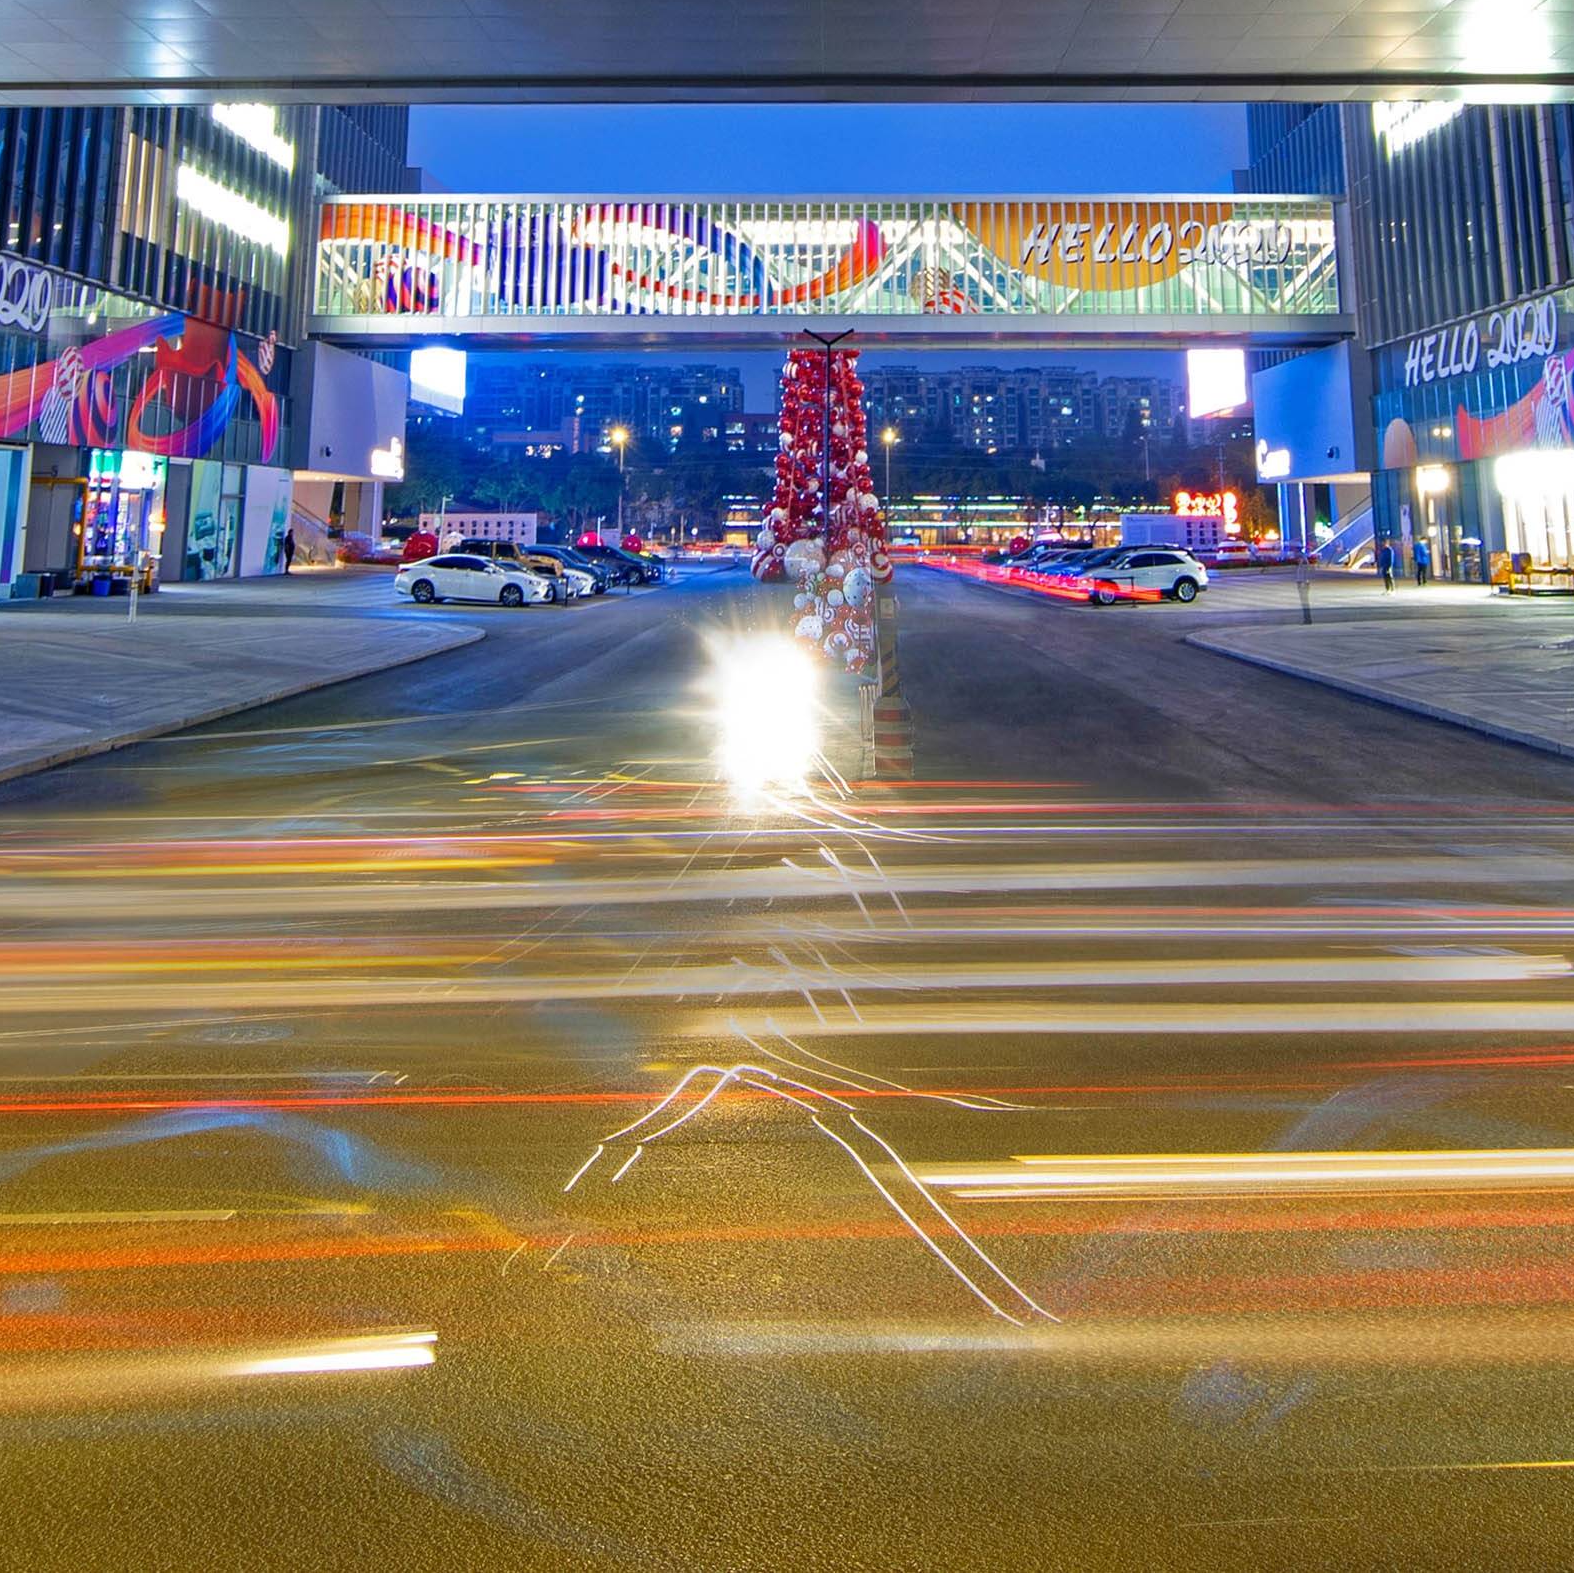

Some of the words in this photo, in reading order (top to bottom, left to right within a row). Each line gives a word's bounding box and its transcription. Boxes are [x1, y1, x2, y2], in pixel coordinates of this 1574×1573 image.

[1021, 220, 1175, 266] HELLO
[1404, 320, 1480, 387] HELLO
[1487, 295, 1558, 369] 2020
